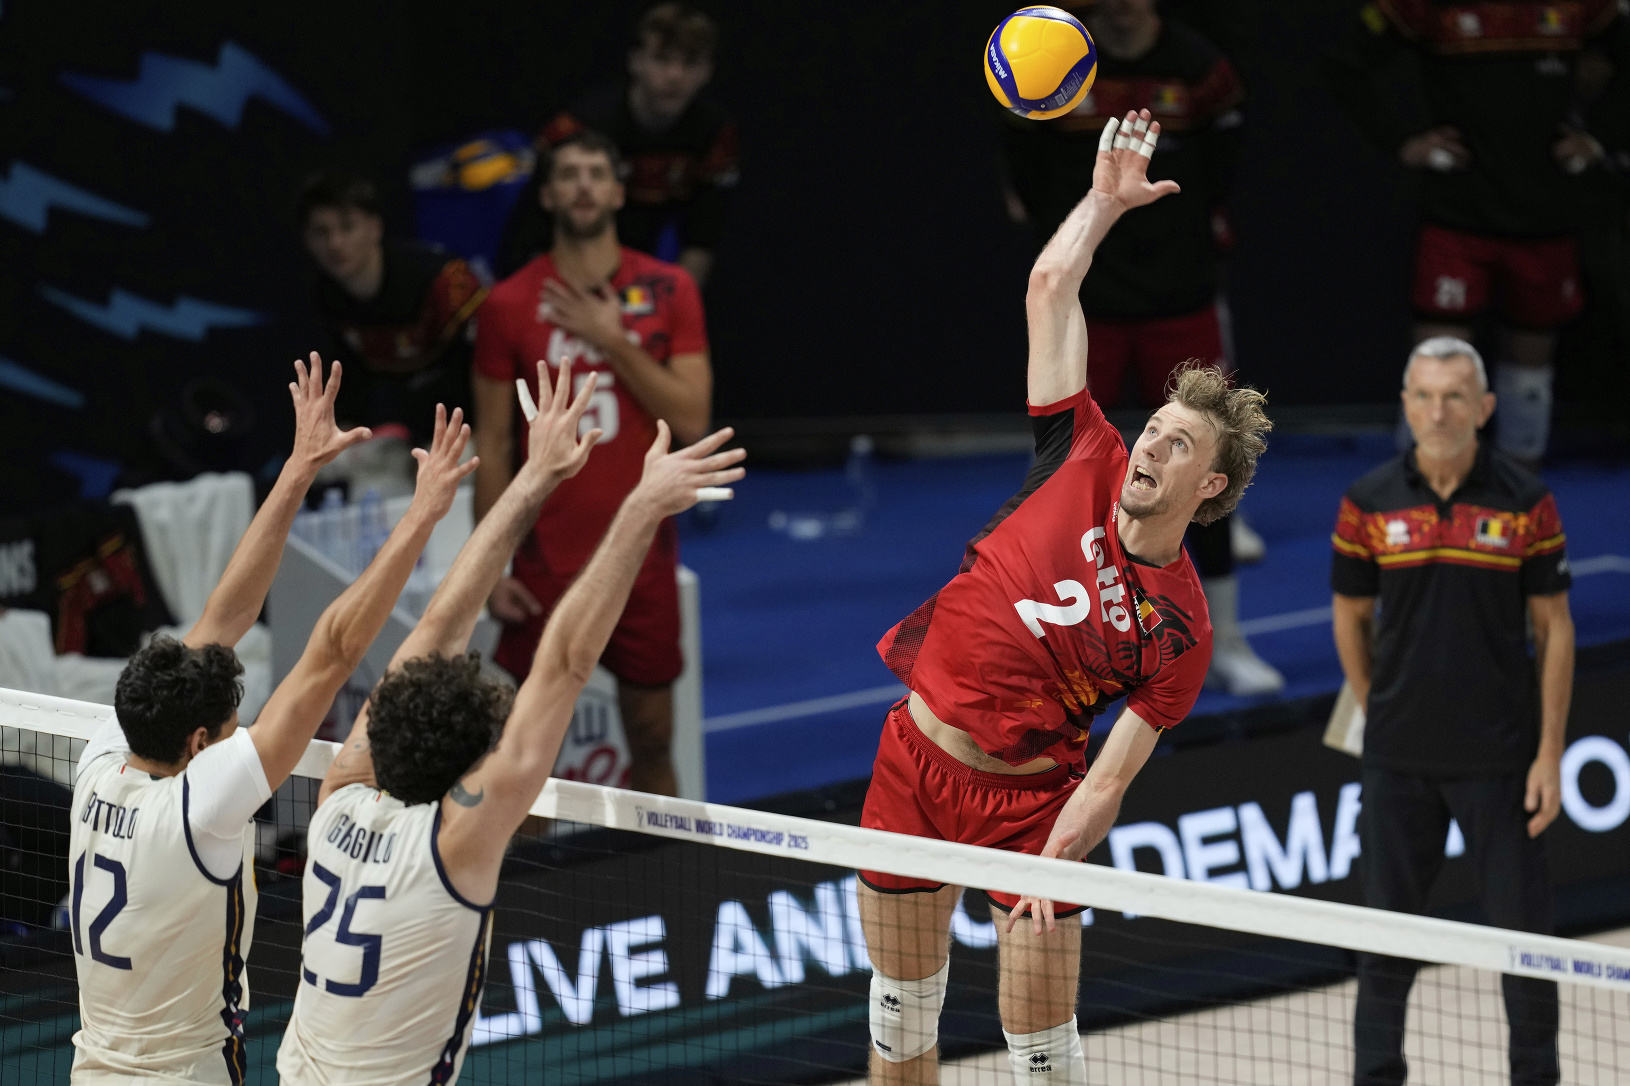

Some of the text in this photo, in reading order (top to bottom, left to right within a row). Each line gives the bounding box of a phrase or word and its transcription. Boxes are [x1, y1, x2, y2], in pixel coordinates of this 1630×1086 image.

[1013, 579, 1091, 639] 2
[82, 791, 139, 839] BTTOLO
[647, 810, 808, 850] VOLLEYBALL WORLD CHAMPIONSHIP 2025
[72, 850, 133, 970] 12
[470, 914, 681, 1046] LIVE
[705, 874, 873, 1000] AN
[1561, 734, 1630, 834] O
[303, 860, 386, 997] 25
[1520, 951, 1567, 973] VOLLEYBALL
[1573, 959, 1602, 978] WORLD
